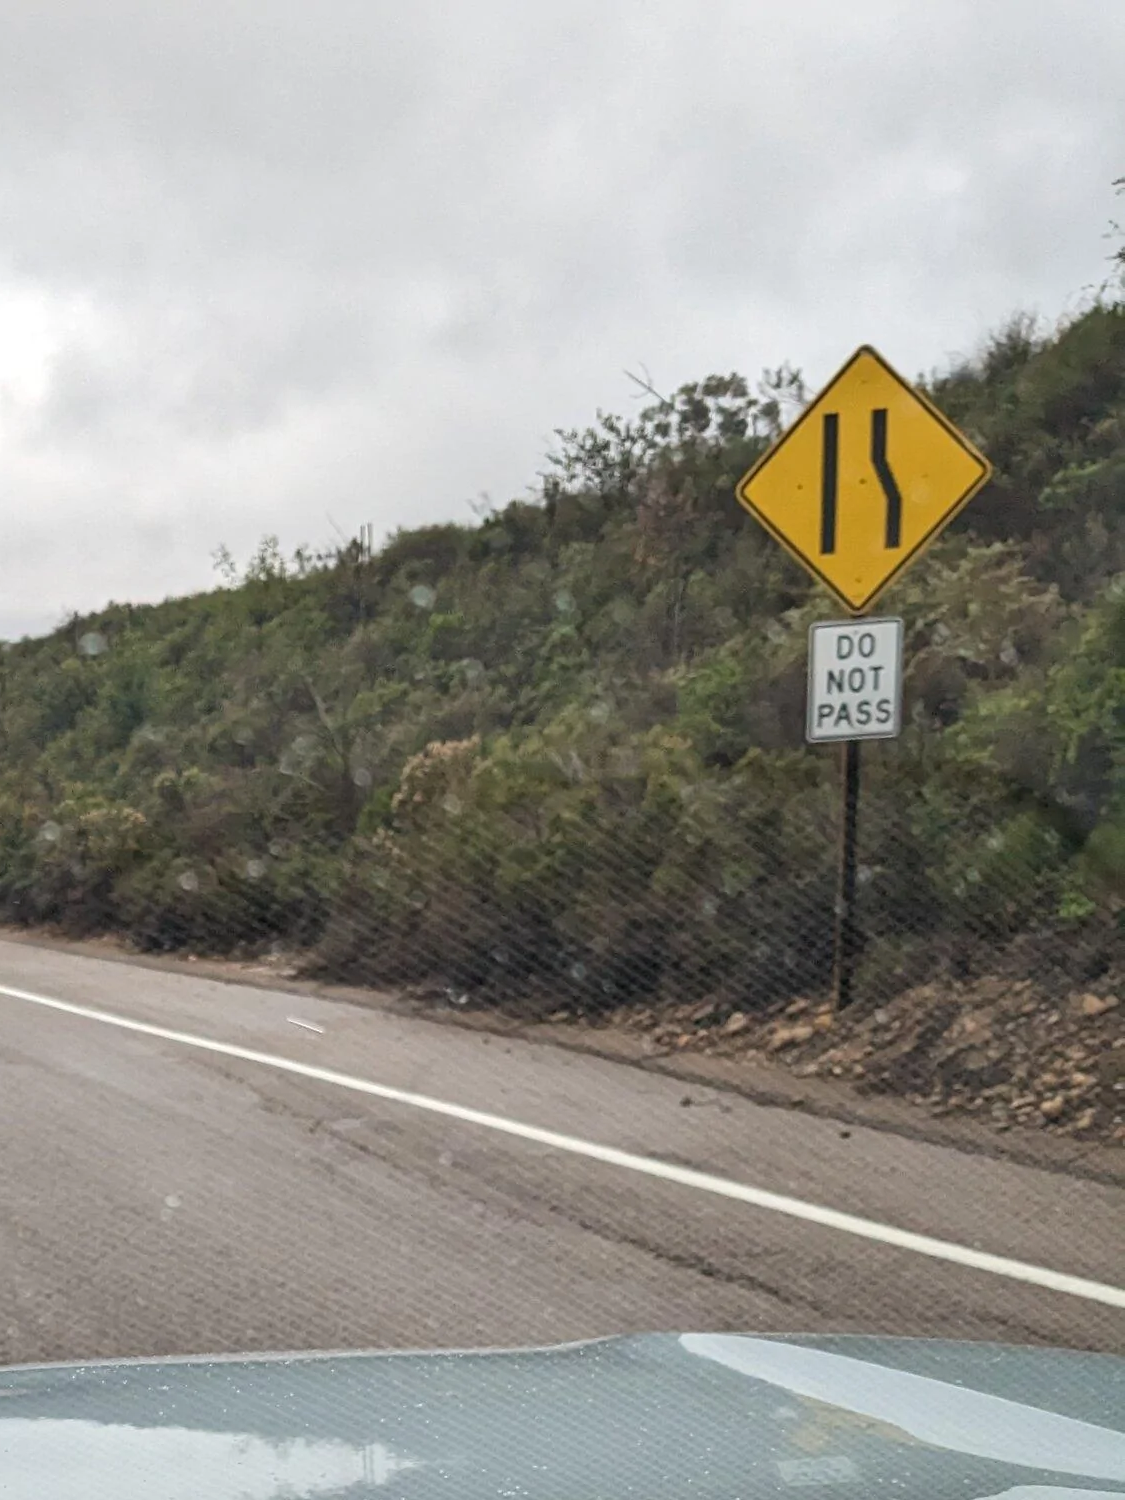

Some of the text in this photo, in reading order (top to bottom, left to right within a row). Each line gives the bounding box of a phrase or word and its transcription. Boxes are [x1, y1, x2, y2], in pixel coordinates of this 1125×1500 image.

[837, 633, 875, 659] DO
[826, 666, 884, 694] NOT
[816, 699, 892, 728] PASS
